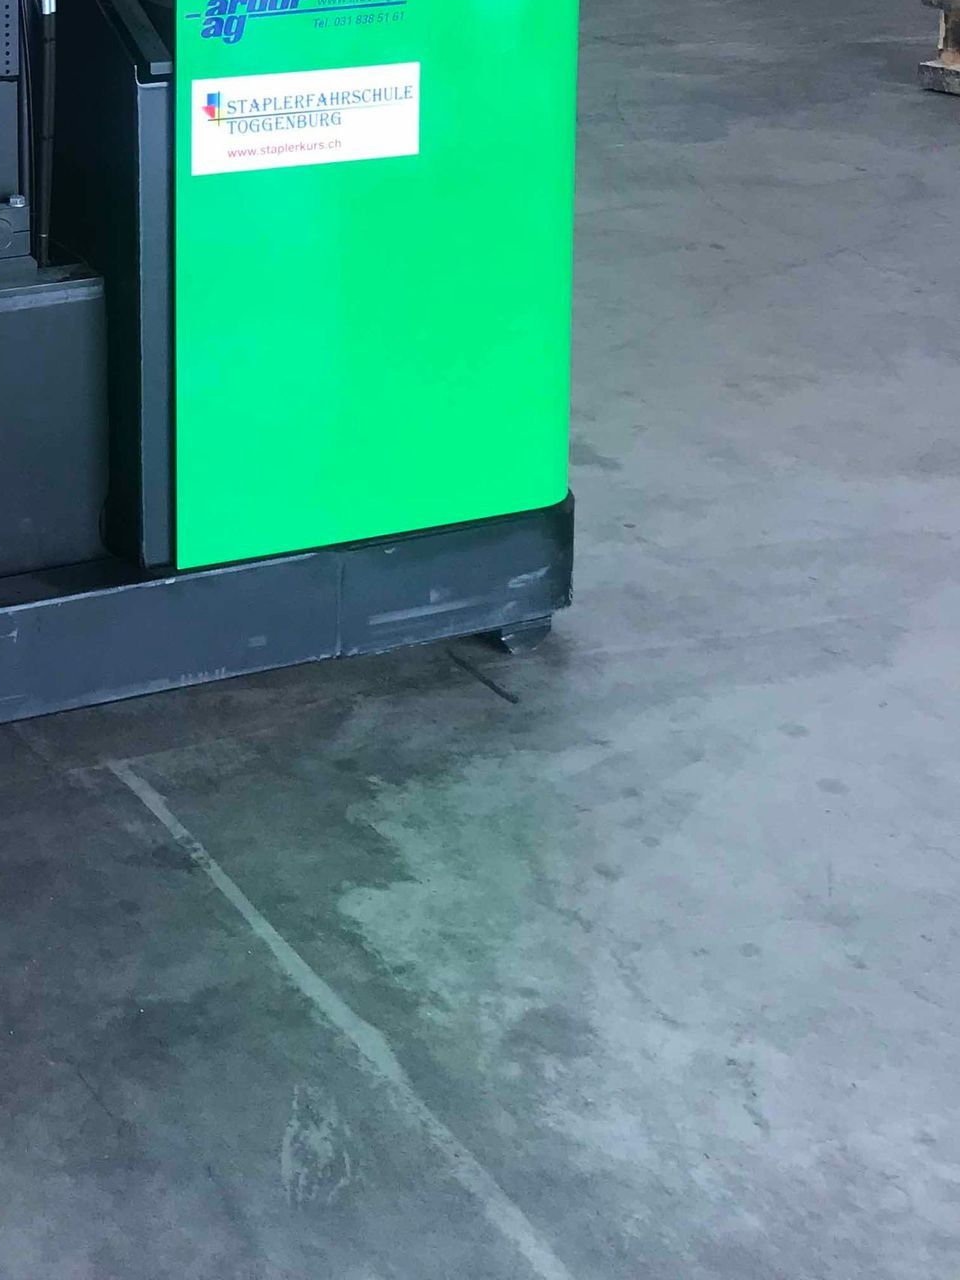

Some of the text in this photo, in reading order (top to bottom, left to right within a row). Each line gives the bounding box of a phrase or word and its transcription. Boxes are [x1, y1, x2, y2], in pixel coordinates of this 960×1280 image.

[200, 14, 247, 45] ag
[334, 16, 352, 26] 031
[355, 13, 375, 24] 838
[377, 12, 389, 22] 51
[227, 85, 413, 114] STAPLERFAHRSCHULE
[226, 112, 342, 135] TOGGENBURG
[227, 139, 342, 158] www.staplerkurs.ch
